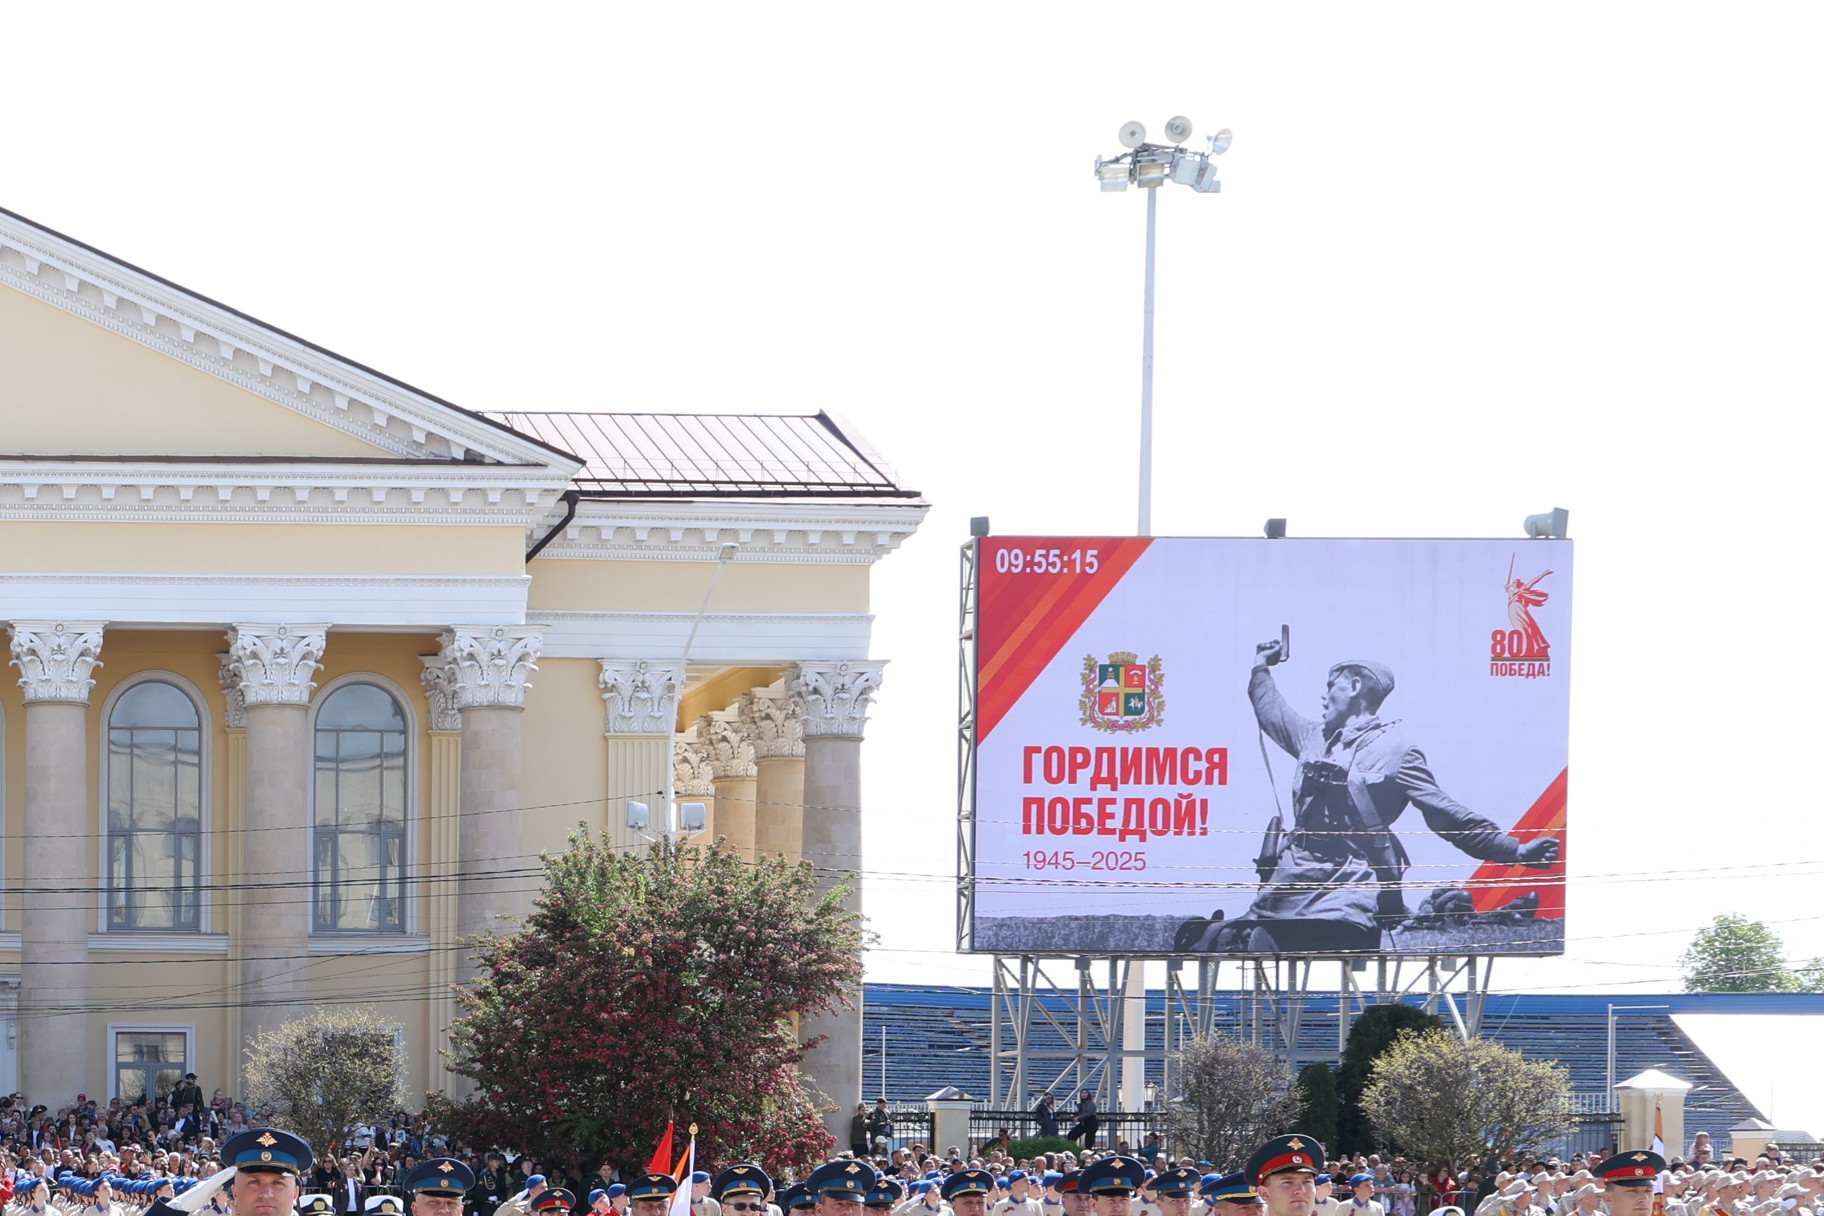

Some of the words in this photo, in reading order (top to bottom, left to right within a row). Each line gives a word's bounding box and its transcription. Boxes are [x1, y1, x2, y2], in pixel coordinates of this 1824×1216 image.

[995, 548, 1099, 574] 09:55:15
[1491, 629, 1523, 657] 80
[1490, 663, 1551, 679] ПОБЕДА!
[1023, 745, 1228, 791] ГОРДИМСЯ
[1022, 793, 1209, 842] ПОБЕДОЙ!
